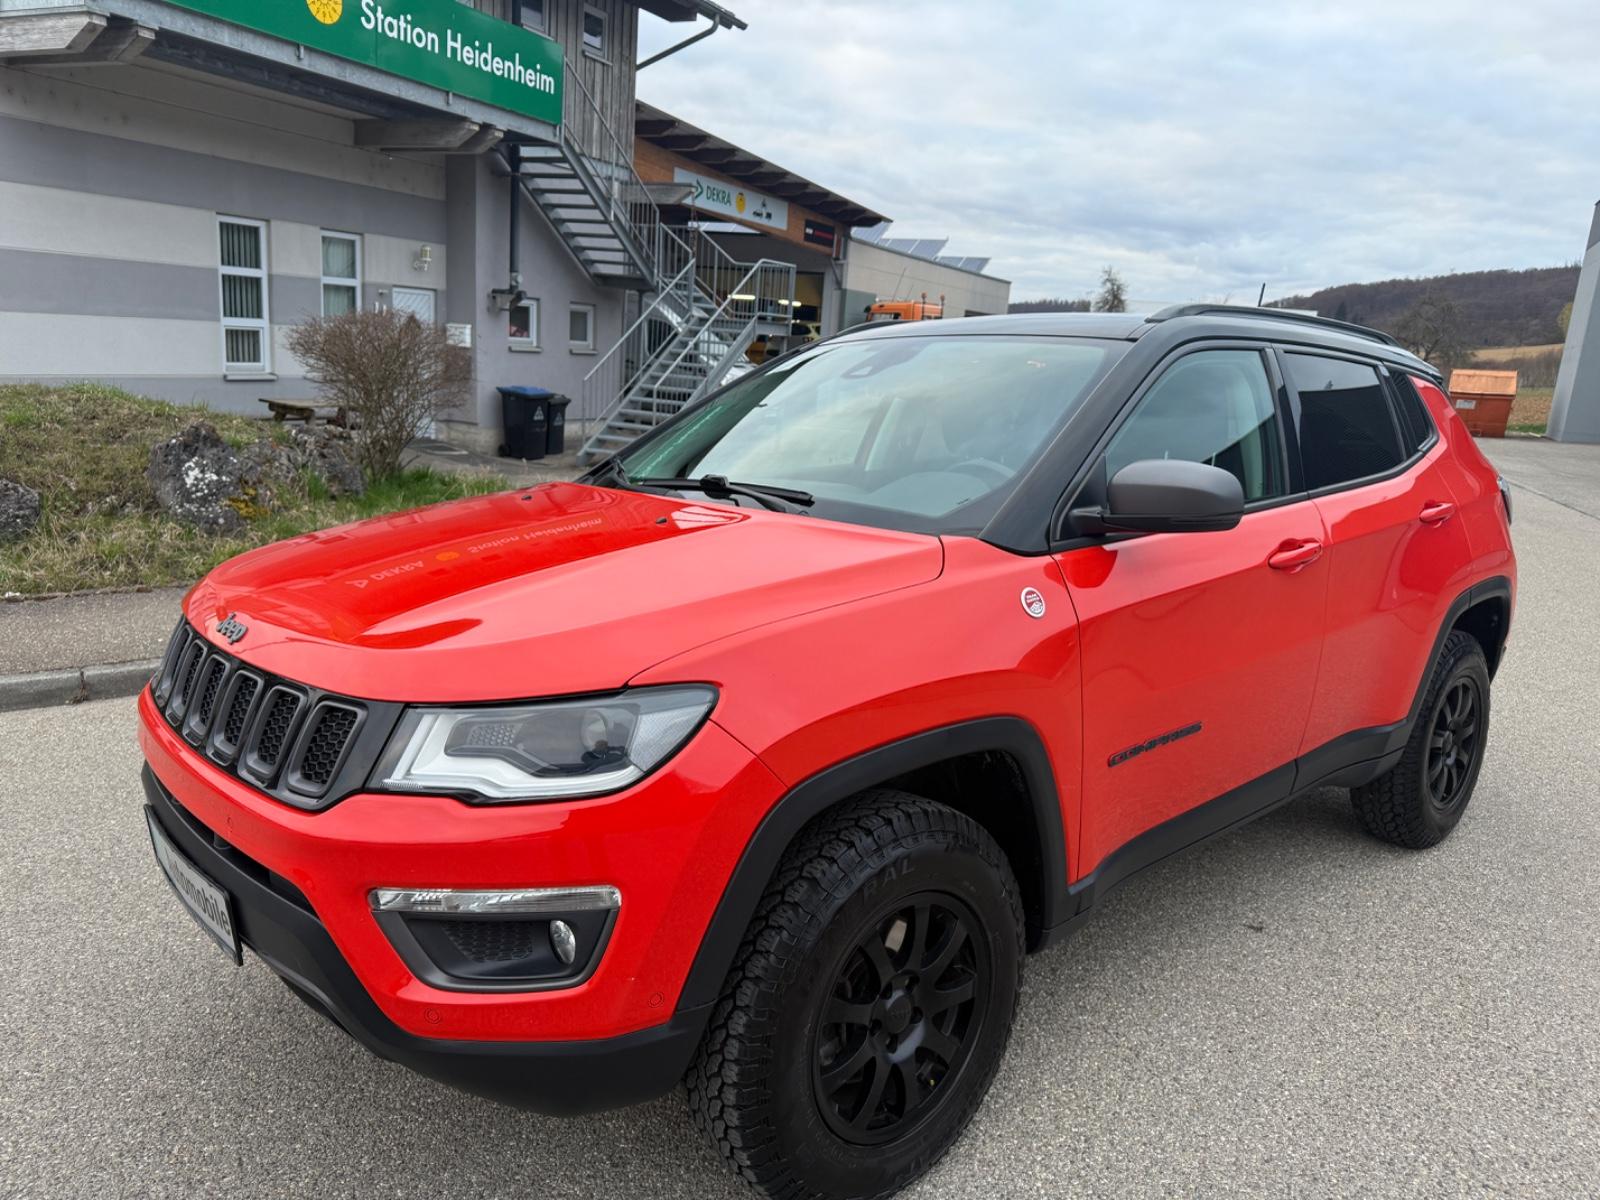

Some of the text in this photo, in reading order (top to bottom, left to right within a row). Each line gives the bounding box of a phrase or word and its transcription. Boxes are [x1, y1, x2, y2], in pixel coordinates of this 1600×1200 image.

[360, 0, 555, 94] Station Heidenheim
[706, 185, 732, 206] DEKRA
[216, 611, 249, 645] Jeep
